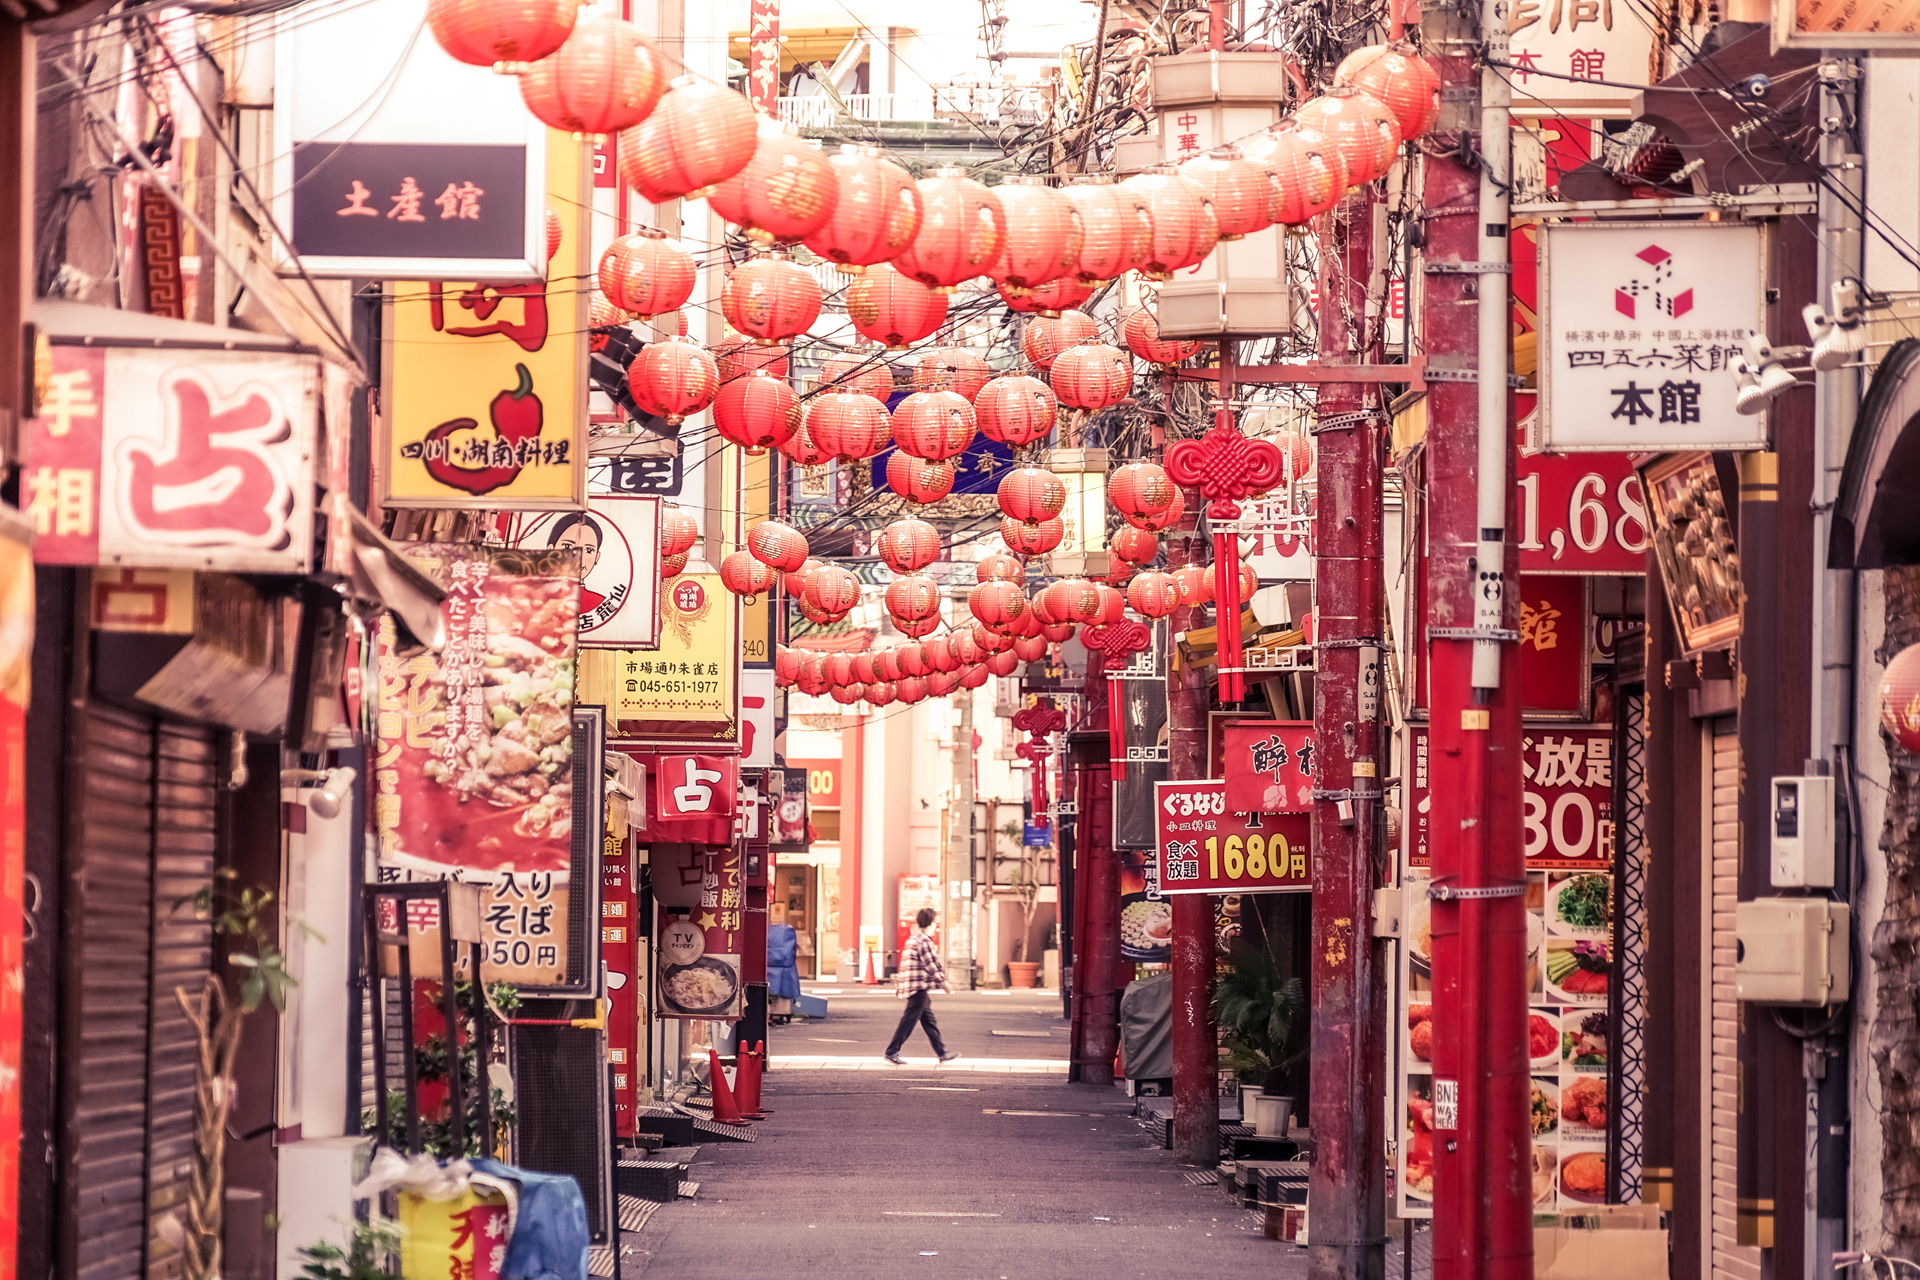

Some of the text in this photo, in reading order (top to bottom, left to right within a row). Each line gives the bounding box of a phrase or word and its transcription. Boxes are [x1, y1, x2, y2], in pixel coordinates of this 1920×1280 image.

[1510, 48, 1605, 84] 本館
[336, 176, 485, 222] 土産館
[1652, 329, 1745, 341] 中國上海料理
[1567, 344, 1743, 373] 四五六菜館
[1611, 379, 1701, 425] 本館
[25, 370, 96, 536] 手相
[121, 371, 283, 545] 占
[442, 560, 470, 775] 食べたことがありますか?
[463, 561, 490, 742] 辛くて美味しい湯麺を
[625, 660, 719, 676] 市場通り朱雀店
[640, 680, 719, 693] 045-651-1977
[1416, 735, 1428, 788] 時間無制限
[673, 758, 722, 812] 占
[1166, 820, 1217, 831] 小皿料理
[1418, 817, 1427, 854] お一人様
[603, 836, 623, 856] 館
[1166, 840, 1198, 860] 食べ
[602, 865, 627, 874] り開く
[1167, 861, 1198, 880] 放題
[485, 905, 553, 934] そば
